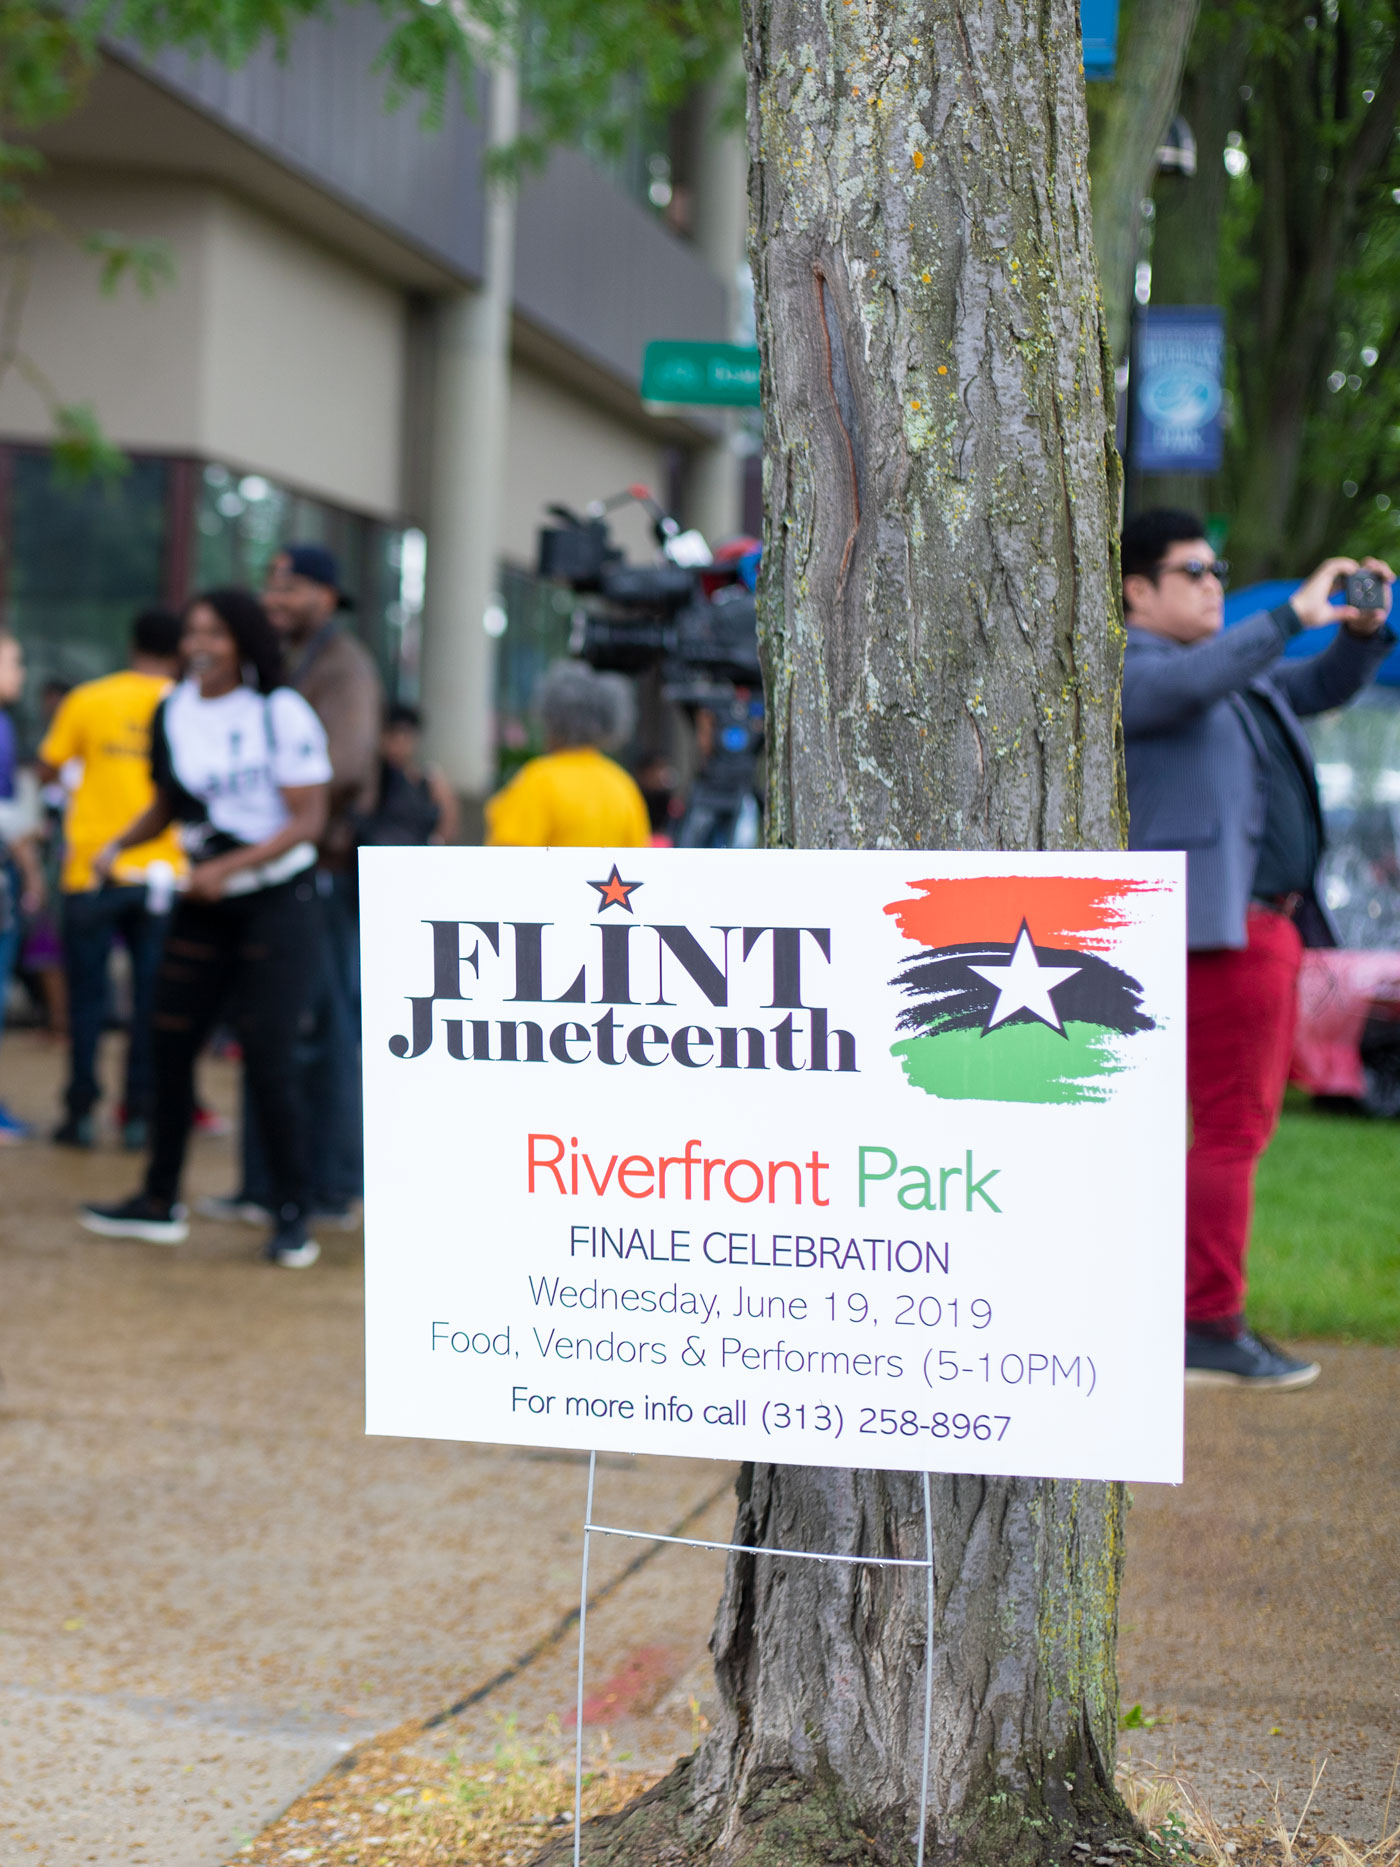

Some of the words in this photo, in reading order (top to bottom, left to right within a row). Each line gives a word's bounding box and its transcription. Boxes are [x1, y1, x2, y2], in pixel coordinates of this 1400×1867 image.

[420, 919, 831, 1008] FLINT
[388, 996, 862, 1073] Juneteenth
[527, 1132, 831, 1207] Riverfront
[858, 1145, 1004, 1214] Park
[570, 1224, 691, 1263] FINALE
[702, 1231, 950, 1275] CELEBRATION
[527, 1274, 721, 1325] Wednesday,
[732, 1285, 808, 1321] June
[824, 1291, 878, 1328] 19,
[894, 1294, 993, 1330] 2019
[431, 1320, 519, 1360] Food,
[532, 1326, 668, 1365] Vendors
[680, 1334, 707, 1368] &
[721, 1336, 904, 1378] Performers
[923, 1347, 1097, 1398] (5-10PM)
[511, 1385, 557, 1415] For
[565, 1396, 635, 1420] more
[644, 1394, 694, 1424] info
[702, 1398, 747, 1427] call
[761, 1400, 844, 1440] (313)
[858, 1407, 1012, 1442] 258-8967
